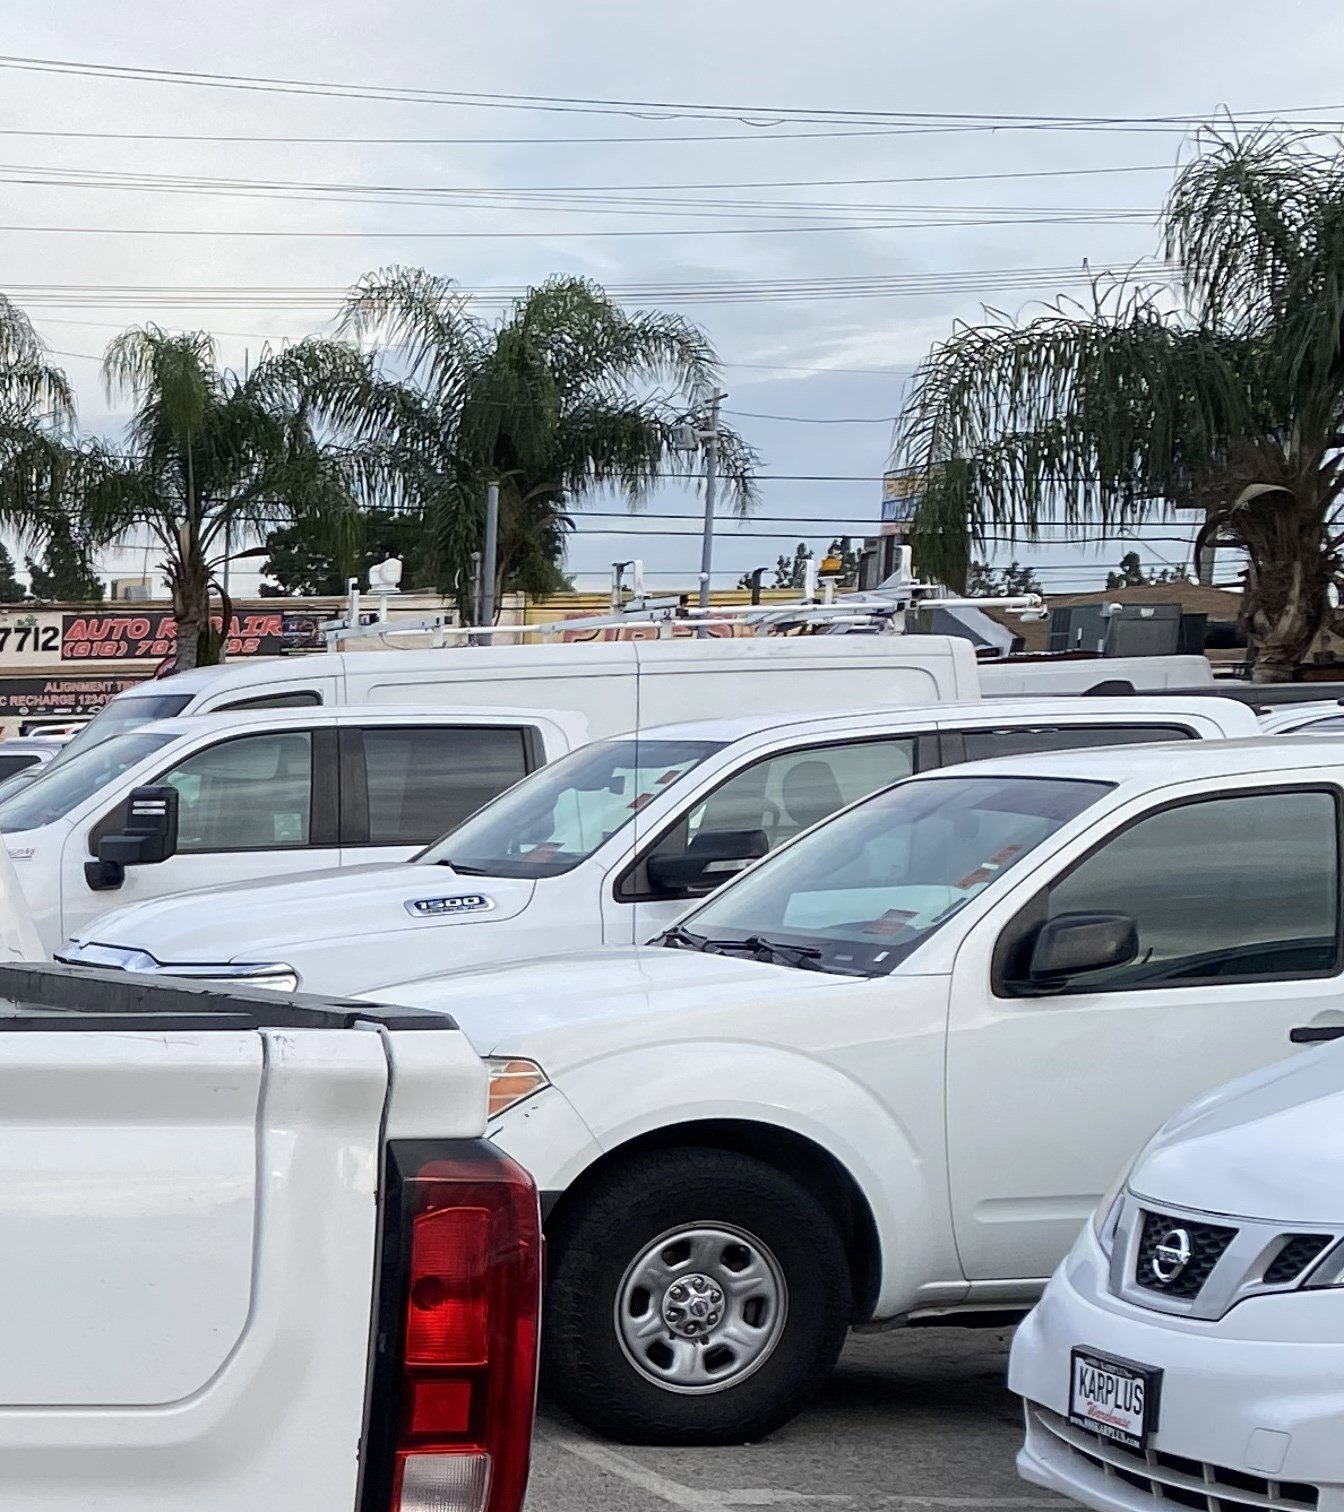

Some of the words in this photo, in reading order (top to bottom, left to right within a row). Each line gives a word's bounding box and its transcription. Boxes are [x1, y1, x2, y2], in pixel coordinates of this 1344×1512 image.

[63, 617, 151, 640] AUTO
[155, 614, 282, 639] RPAIR
[62, 641, 128, 657] (818)
[43, 681, 113, 693] ALIGNMENT
[9, 693, 76, 706] RECHARGE
[419, 896, 481, 910] 1500
[1078, 1366, 1144, 1415] KARPLUS
